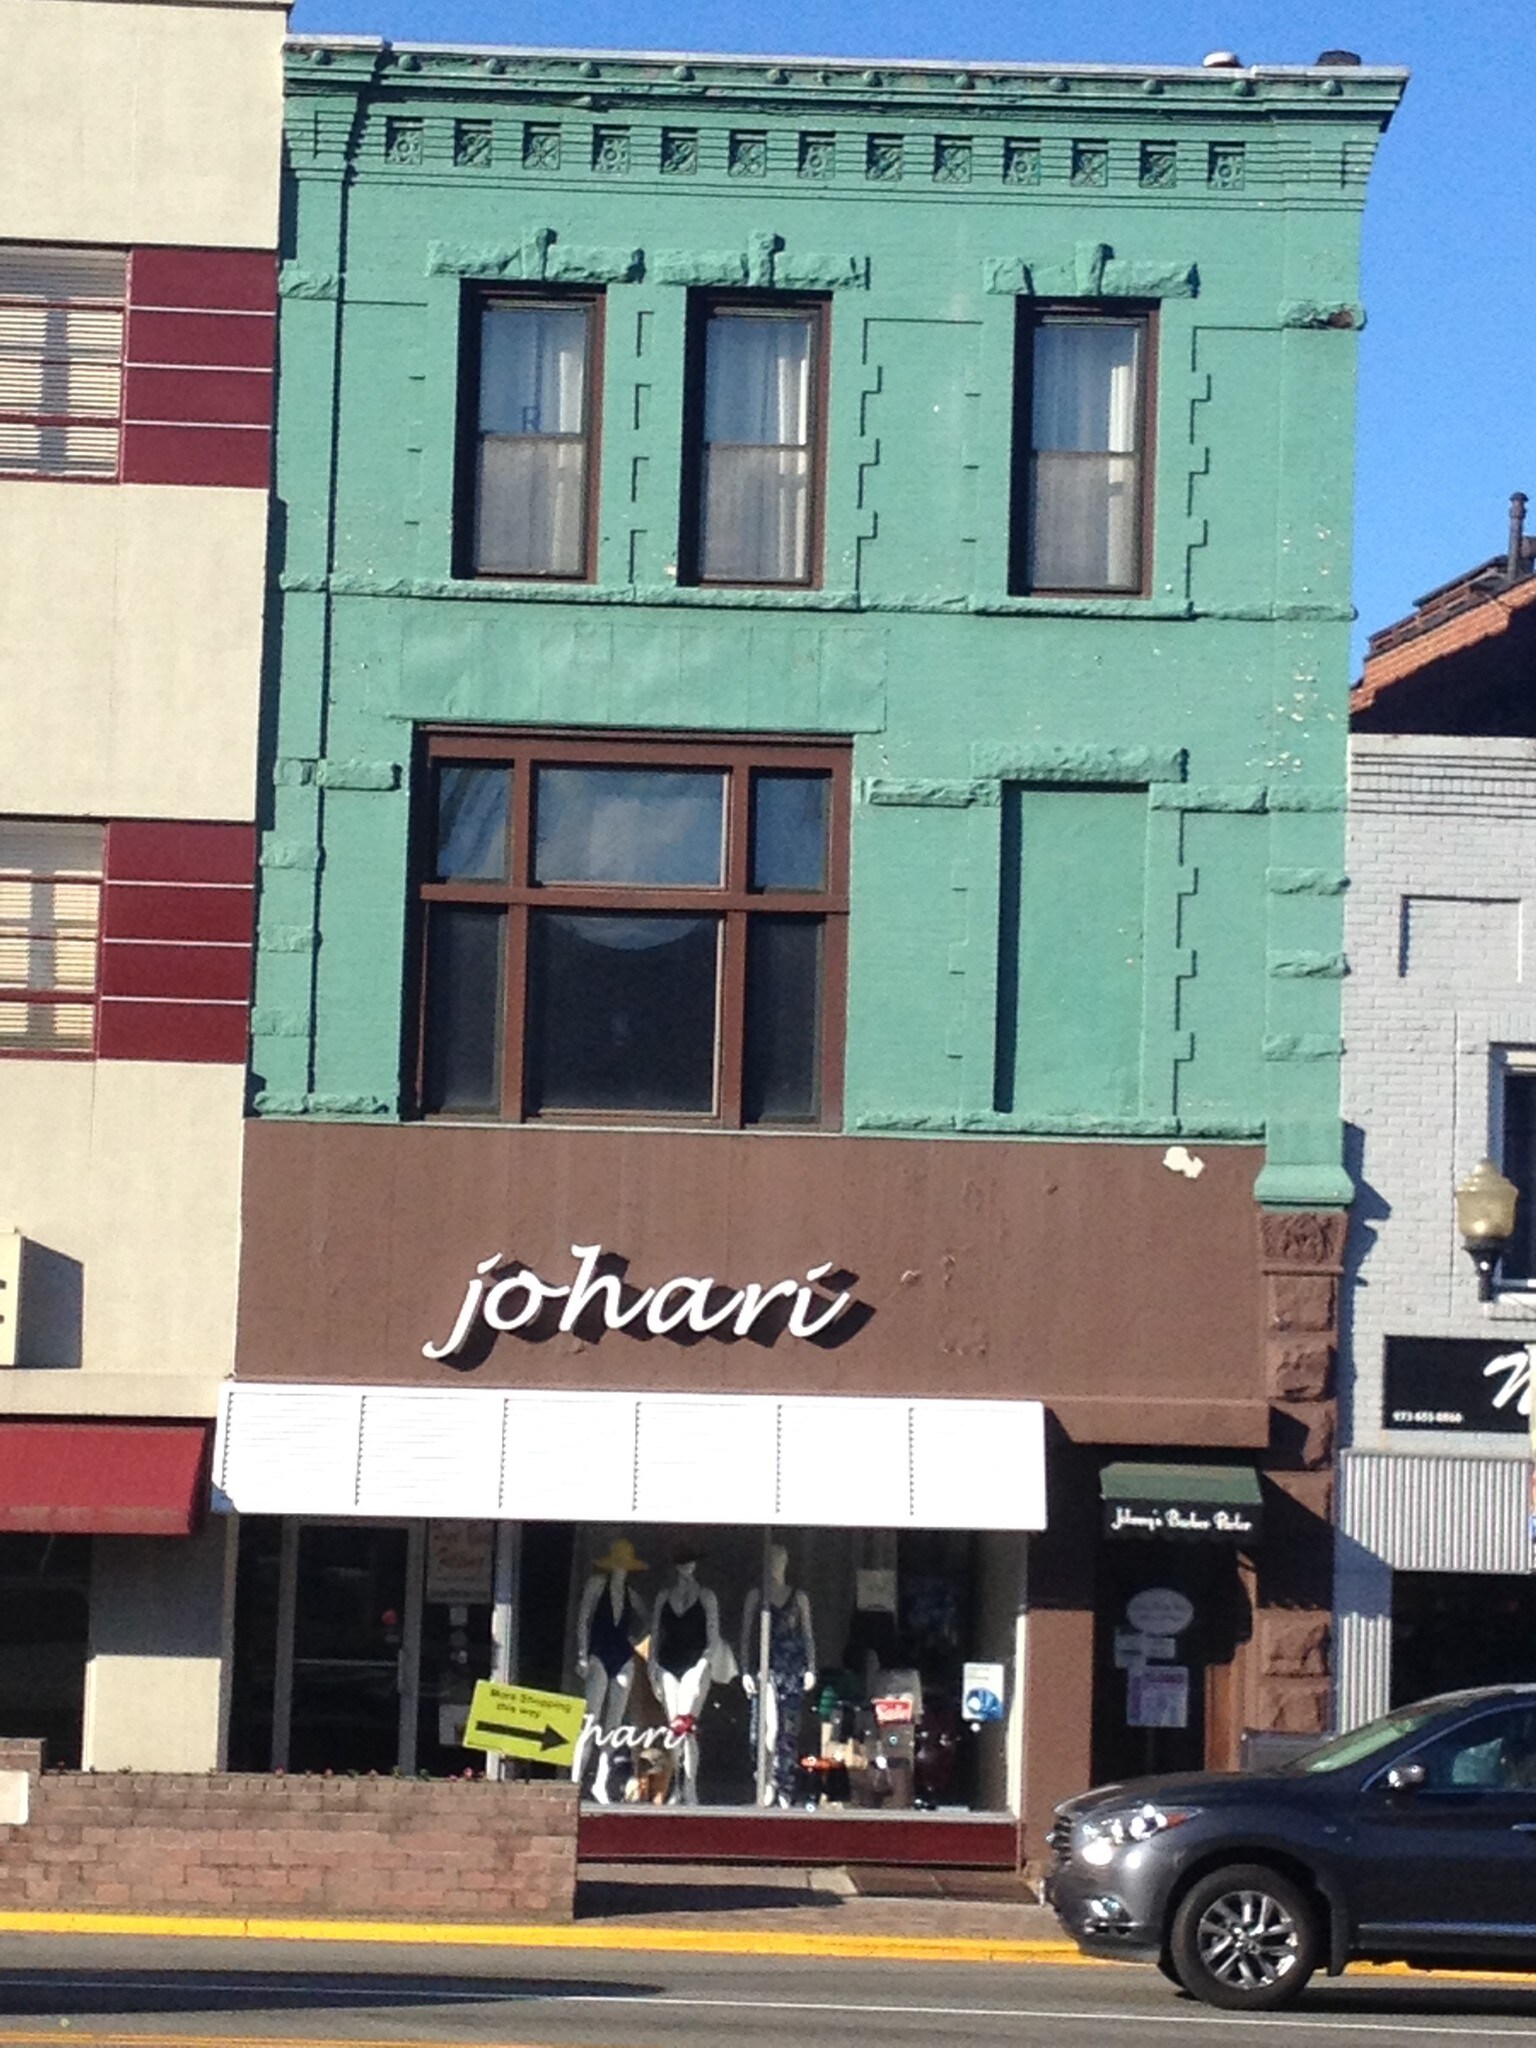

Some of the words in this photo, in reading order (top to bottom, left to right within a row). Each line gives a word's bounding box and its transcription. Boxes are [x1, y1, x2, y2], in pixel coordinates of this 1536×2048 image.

[422, 1244, 850, 1359] johari
[490, 1688, 516, 1701] More
[520, 1693, 573, 1714] Shopping
[519, 1708, 541, 1719] way
[582, 1713, 688, 1750] hari
